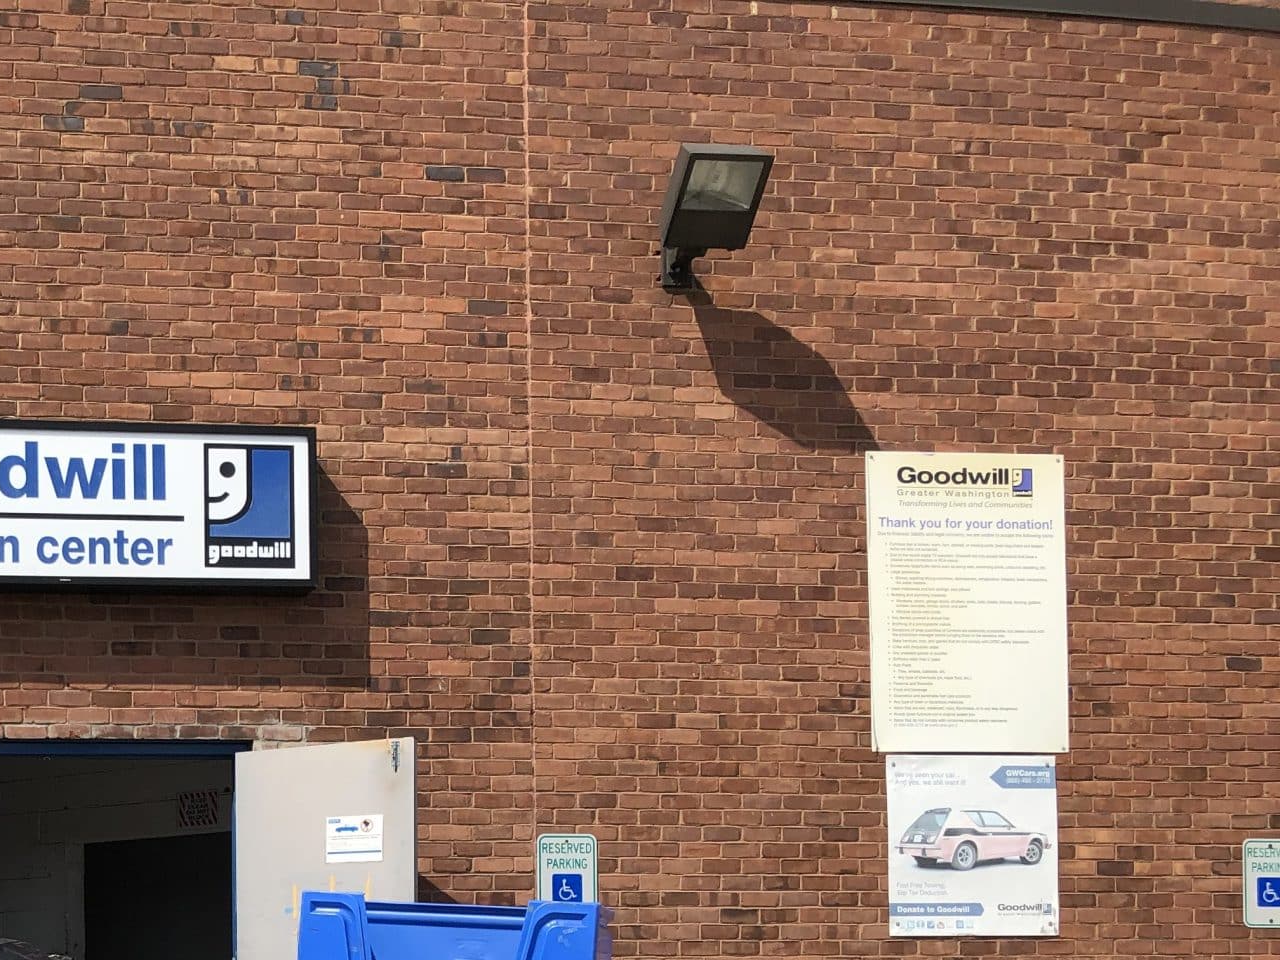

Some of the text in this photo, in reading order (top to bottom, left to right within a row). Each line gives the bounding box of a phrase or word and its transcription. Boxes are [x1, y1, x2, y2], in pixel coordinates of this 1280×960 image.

[897, 466, 1009, 485] Goodwill
[896, 489, 1010, 500] Greater Washington
[878, 517, 1053, 532] Thank you for your donation!
[37, 530, 173, 566] center
[208, 541, 291, 563] goodwill
[542, 842, 592, 854] RESERVED
[1247, 847, 1280, 858] RESERV
[547, 858, 588, 870] PARKING
[1251, 862, 1280, 872] PARKI
[997, 903, 1042, 911] Goodwill
